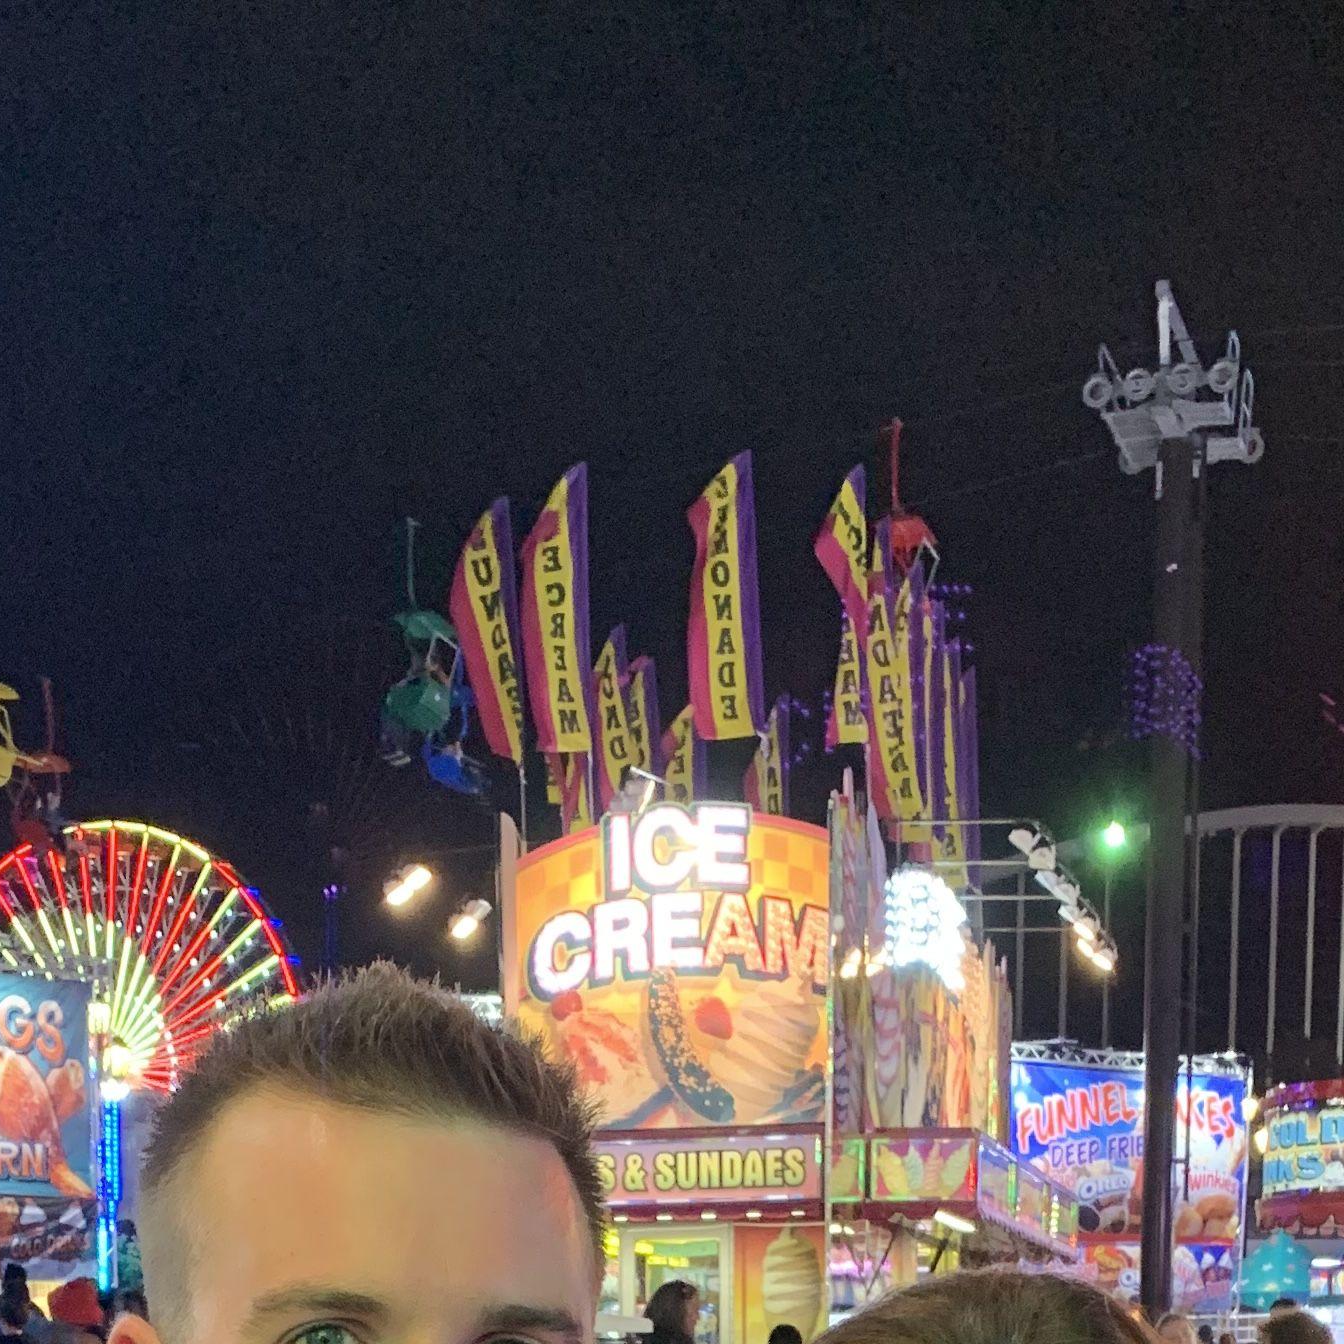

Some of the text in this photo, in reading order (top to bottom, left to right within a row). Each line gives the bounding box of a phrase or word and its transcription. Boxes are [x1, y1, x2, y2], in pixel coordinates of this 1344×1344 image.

[603, 802, 752, 897] ICE
[529, 893, 830, 1000] CREAM
[1016, 1081, 1236, 1154] FUNNEL KES
[1048, 1133, 1145, 1168] DEEP FRIE
[622, 1153, 648, 1191] &
[654, 1148, 806, 1191] SUNDAES
